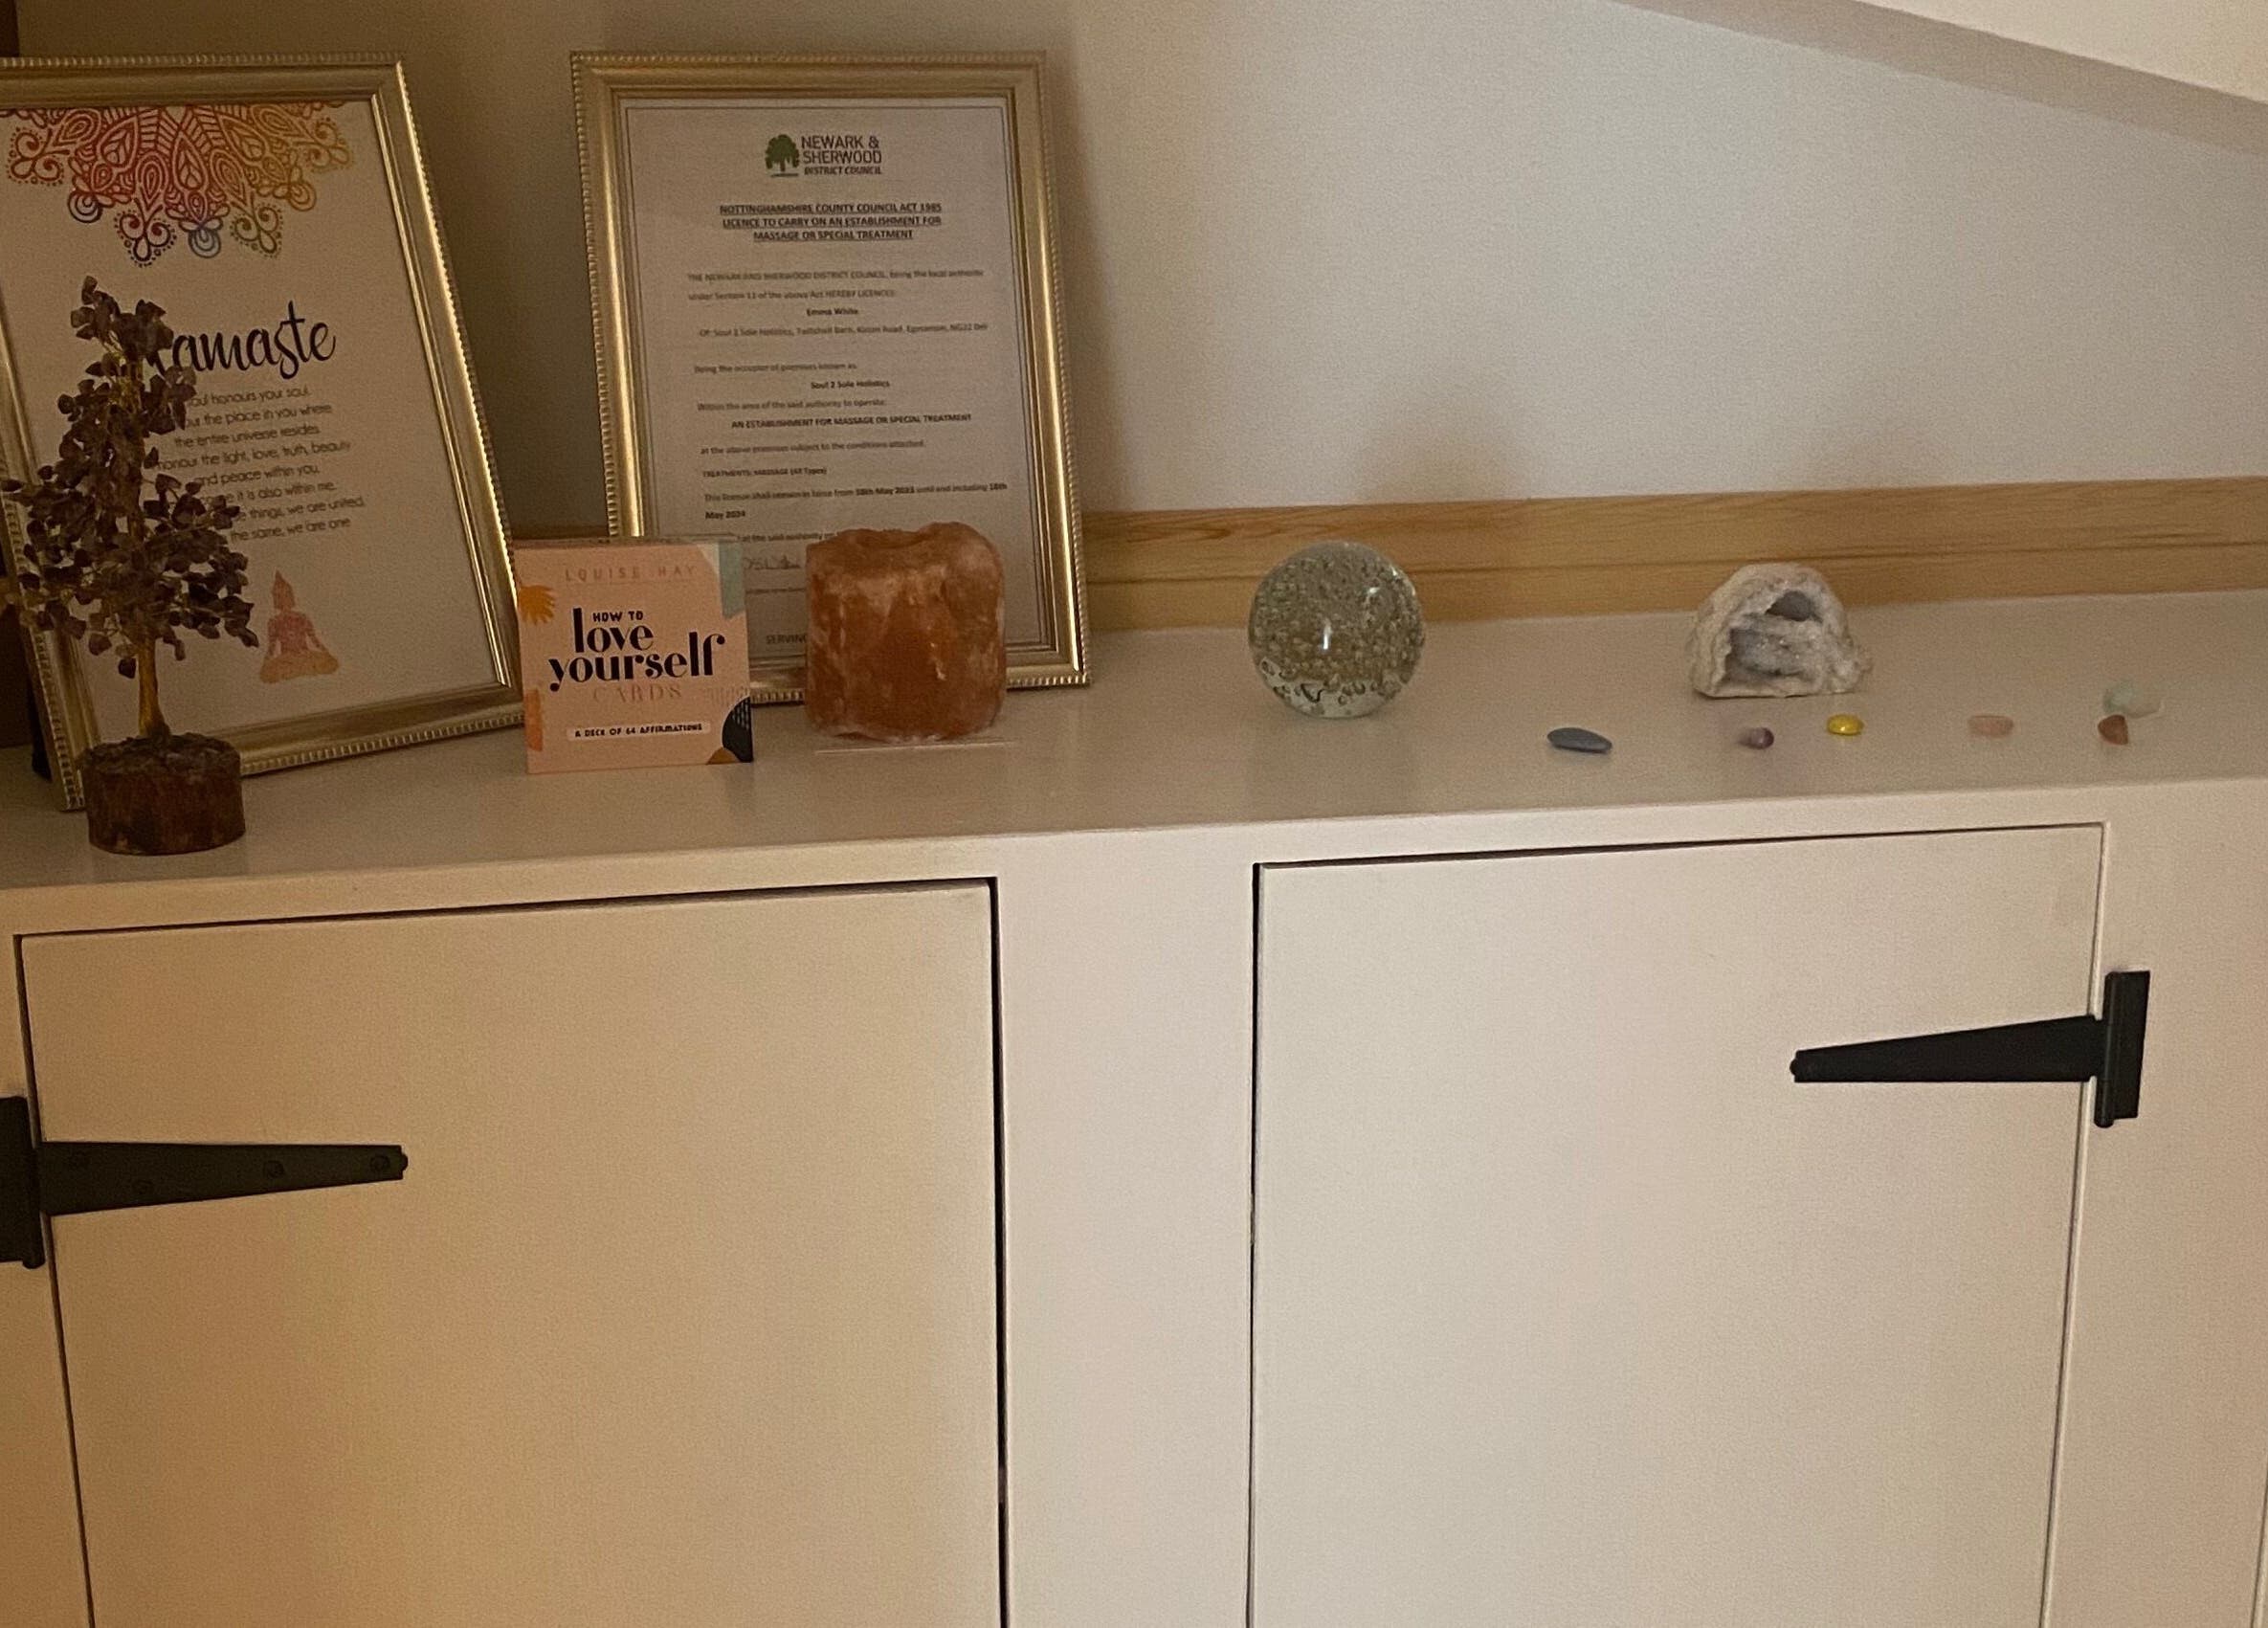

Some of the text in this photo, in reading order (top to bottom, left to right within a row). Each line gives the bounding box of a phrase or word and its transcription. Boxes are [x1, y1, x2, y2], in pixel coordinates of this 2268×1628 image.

[801, 136, 879, 149] NEWARK &
[803, 150, 882, 165] SHERWOOD
[804, 166, 882, 175] DISTRICT COUNCIL
[720, 204, 812, 215] NOTTINGHAMSHIRE
[815, 204, 855, 214] COUNTY
[856, 203, 898, 214] COUNCIL
[900, 203, 918, 213] ACT
[723, 216, 942, 229] LICENCE TO CARRY ON AN ESTABLISHMENT FOR
[753, 230, 913, 241] MASSAGE OR SPECIAL TREATMENT
[704, 273, 741, 282] NEWARK
[764, 272, 812, 280] SHERWOOD
[814, 271, 849, 279] DISTRICT
[211, 390, 256, 406] honours
[258, 389, 283, 402] your
[204, 413, 222, 425] the
[225, 409, 261, 425] place
[275, 406, 299, 420] you
[300, 403, 333, 415] where
[746, 418, 813, 428] ESTABLISHMENT
[815, 418, 833, 427] FOR
[834, 416, 874, 425] MASSAGE
[890, 415, 921, 424] SPECIAL
[923, 413, 971, 422] TREATMENT
[232, 430, 278, 443] universe
[200, 454, 221, 466] the
[220, 470, 261, 485] peace
[257, 487, 282, 499] also
[287, 504, 304, 515] we
[306, 502, 326, 513] are
[704, 511, 723, 520] May
[286, 524, 303, 533] we
[306, 522, 326, 532] are
[566, 565, 698, 582] LOUISE HAY
[592, 611, 644, 622] HOW TO
[572, 607, 654, 654] love
[548, 631, 725, 692] yourself
[593, 683, 682, 703] CARDS
[610, 727, 621, 736] OF
[640, 724, 702, 734] AFFIRMATIONS
